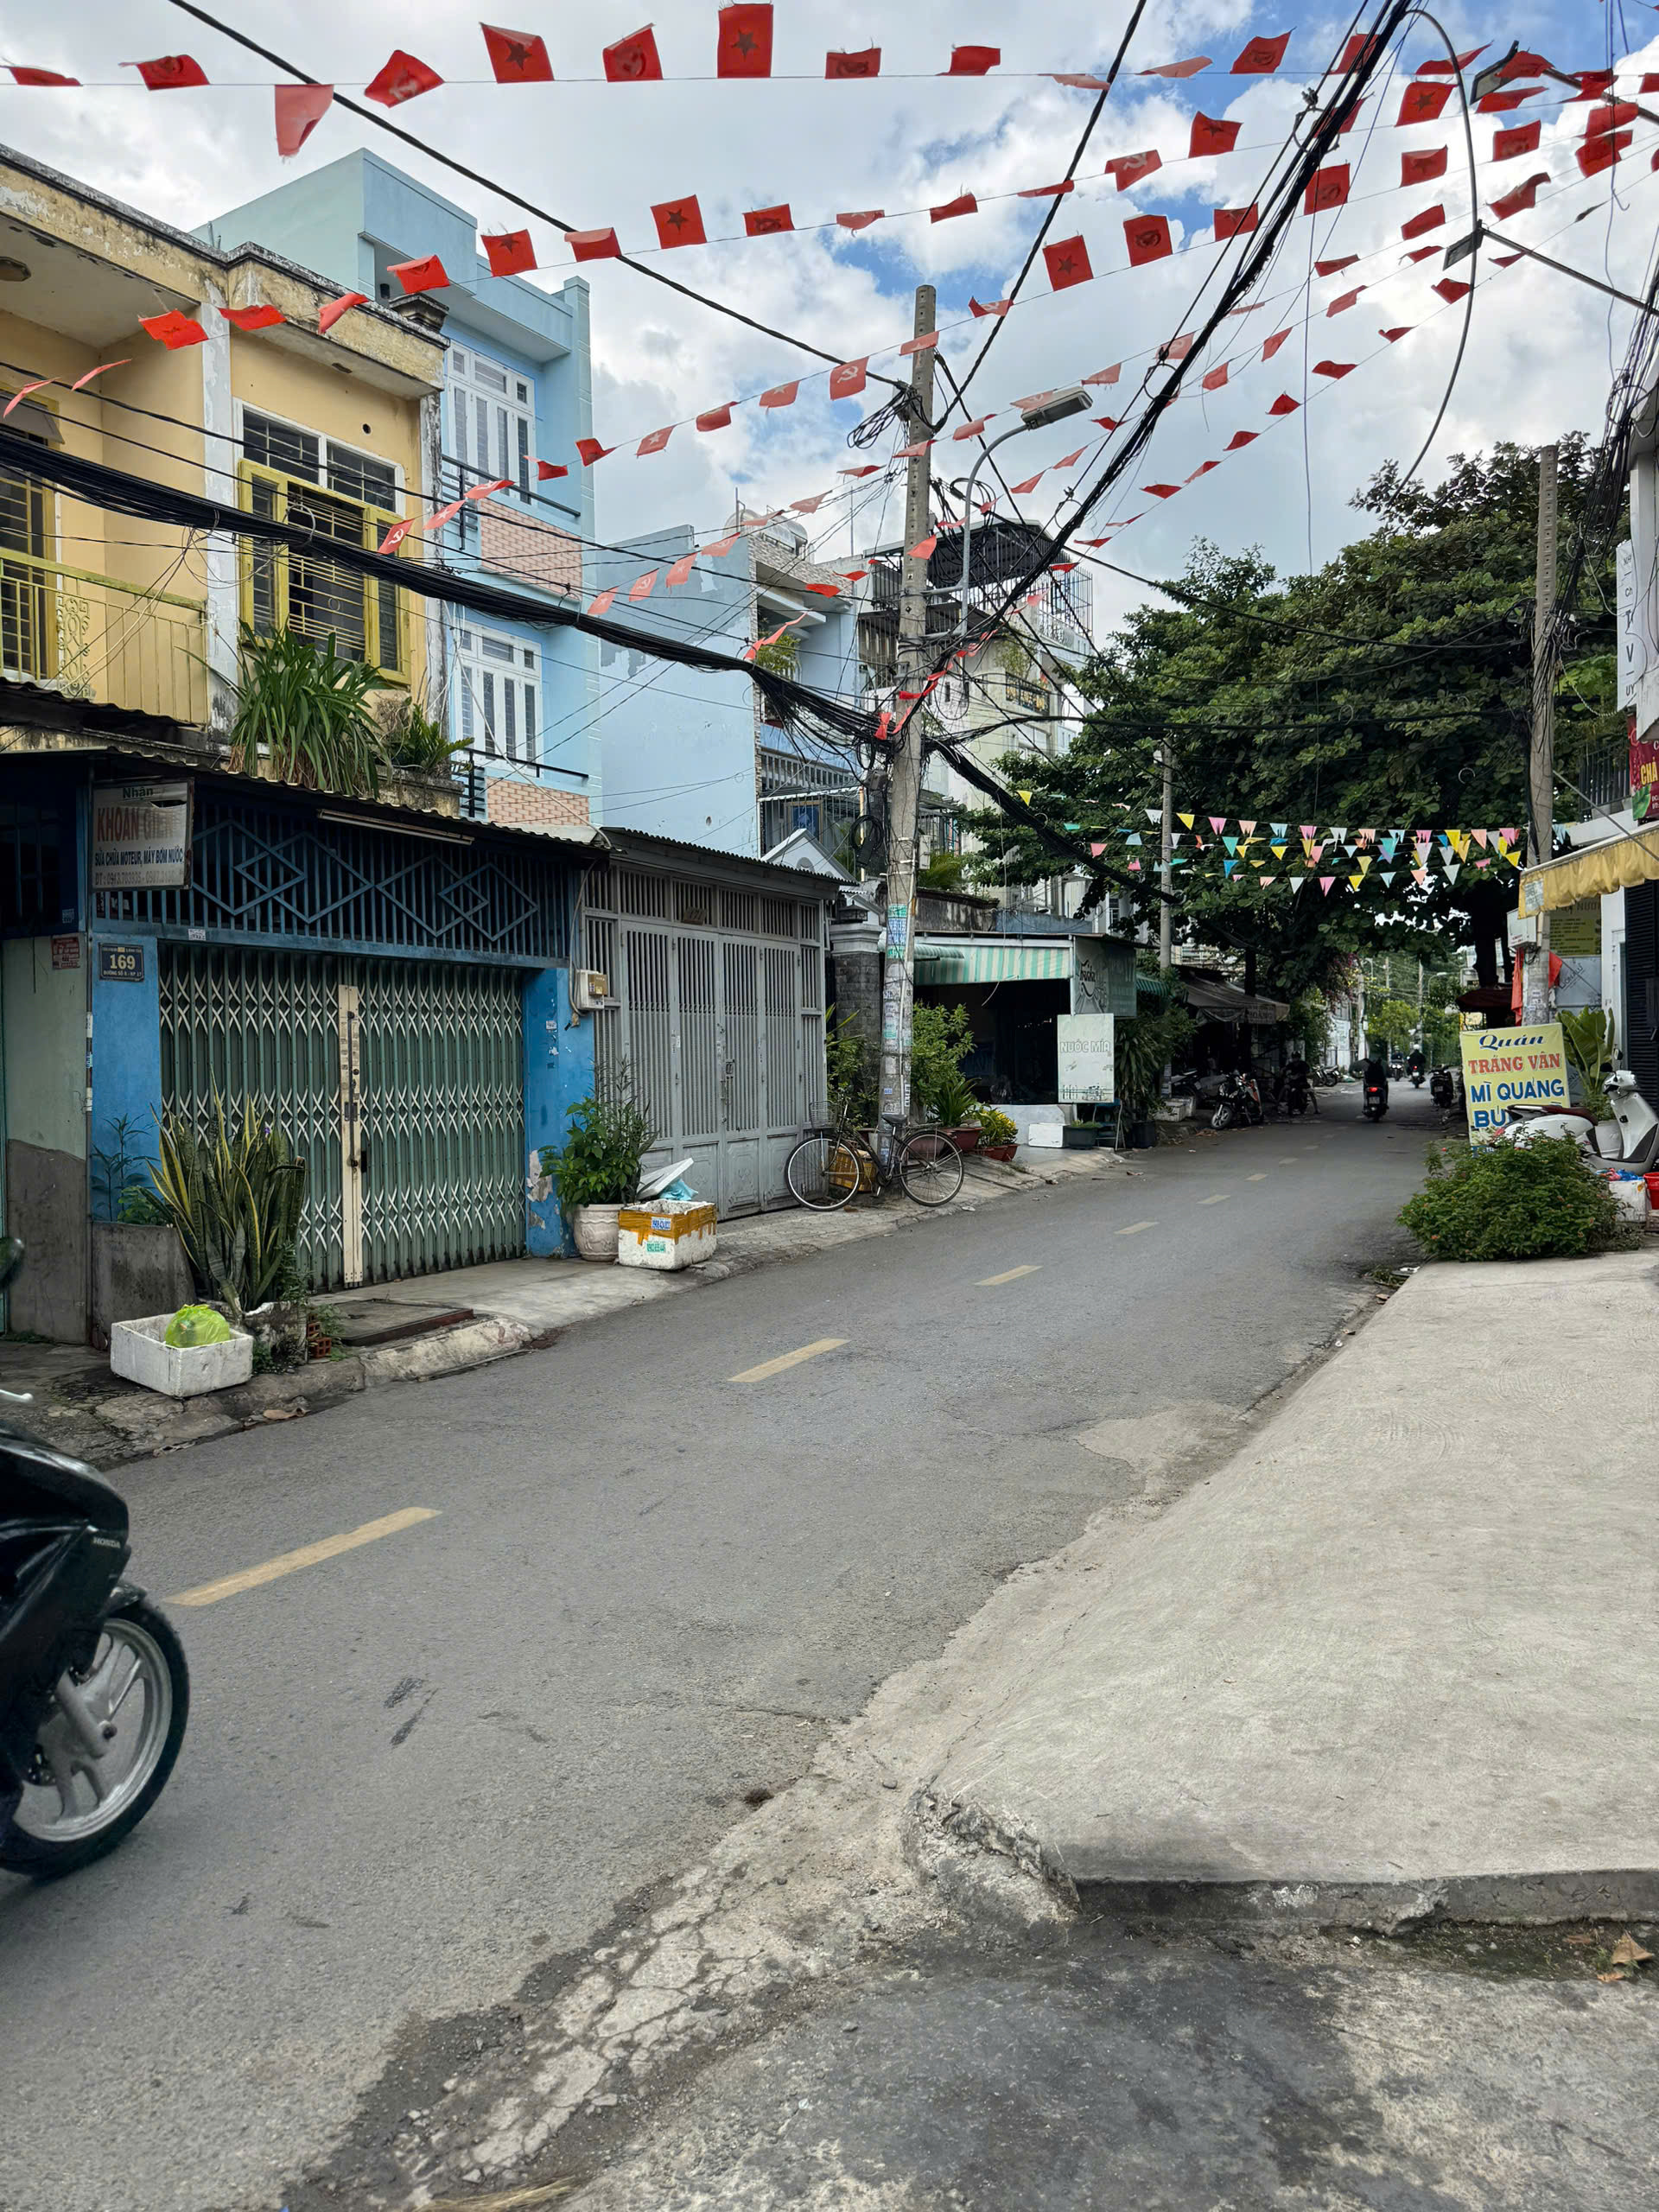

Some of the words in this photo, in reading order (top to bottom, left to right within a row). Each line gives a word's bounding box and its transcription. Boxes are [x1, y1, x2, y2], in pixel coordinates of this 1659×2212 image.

[123, 787, 154, 801] Nhận
[98, 807, 139, 842] KHOAN
[143, 847, 156, 864] MÁY
[110, 954, 136, 969] 169
[1090, 1039, 1110, 1052] MÍA
[1479, 1034, 1544, 1051] Quán
[1527, 1052, 1560, 1070] VÂN
[1471, 1080, 1491, 1103] MÌ
[1473, 1105, 1511, 1128] BÚ
